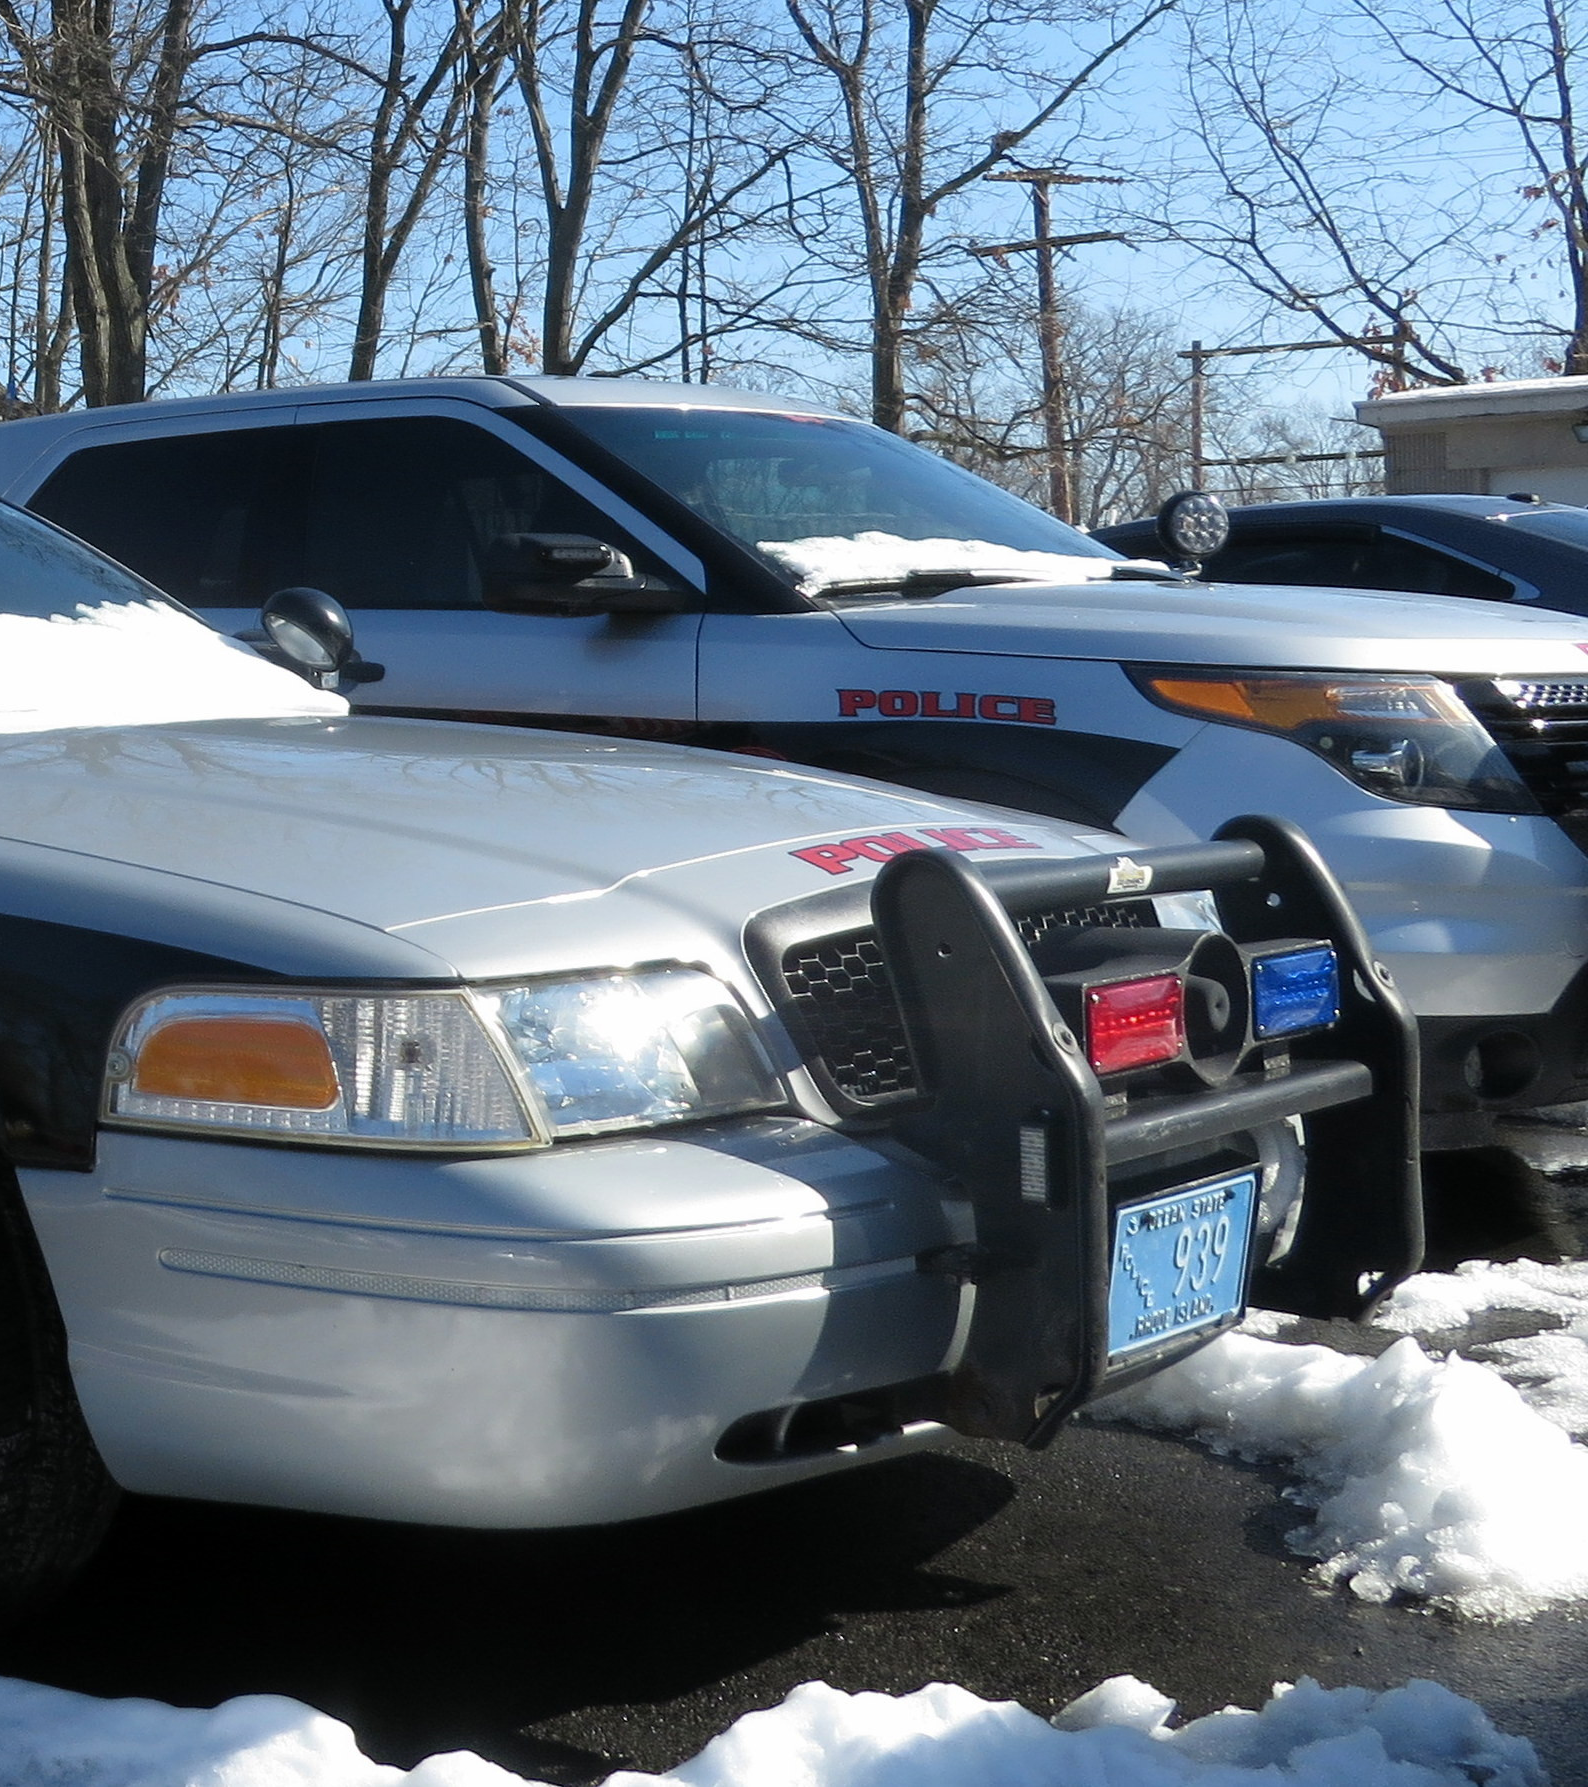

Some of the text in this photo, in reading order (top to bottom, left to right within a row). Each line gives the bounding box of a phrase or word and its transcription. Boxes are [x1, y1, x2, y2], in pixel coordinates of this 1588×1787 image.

[835, 688, 1057, 725] POLICE
[788, 827, 1043, 876] POLICE
[1191, 1191, 1226, 1220] STATE
[1118, 1243, 1155, 1310] POLICE
[1172, 1215, 1230, 1298] 939
[1173, 1292, 1212, 1328] ISLAND
